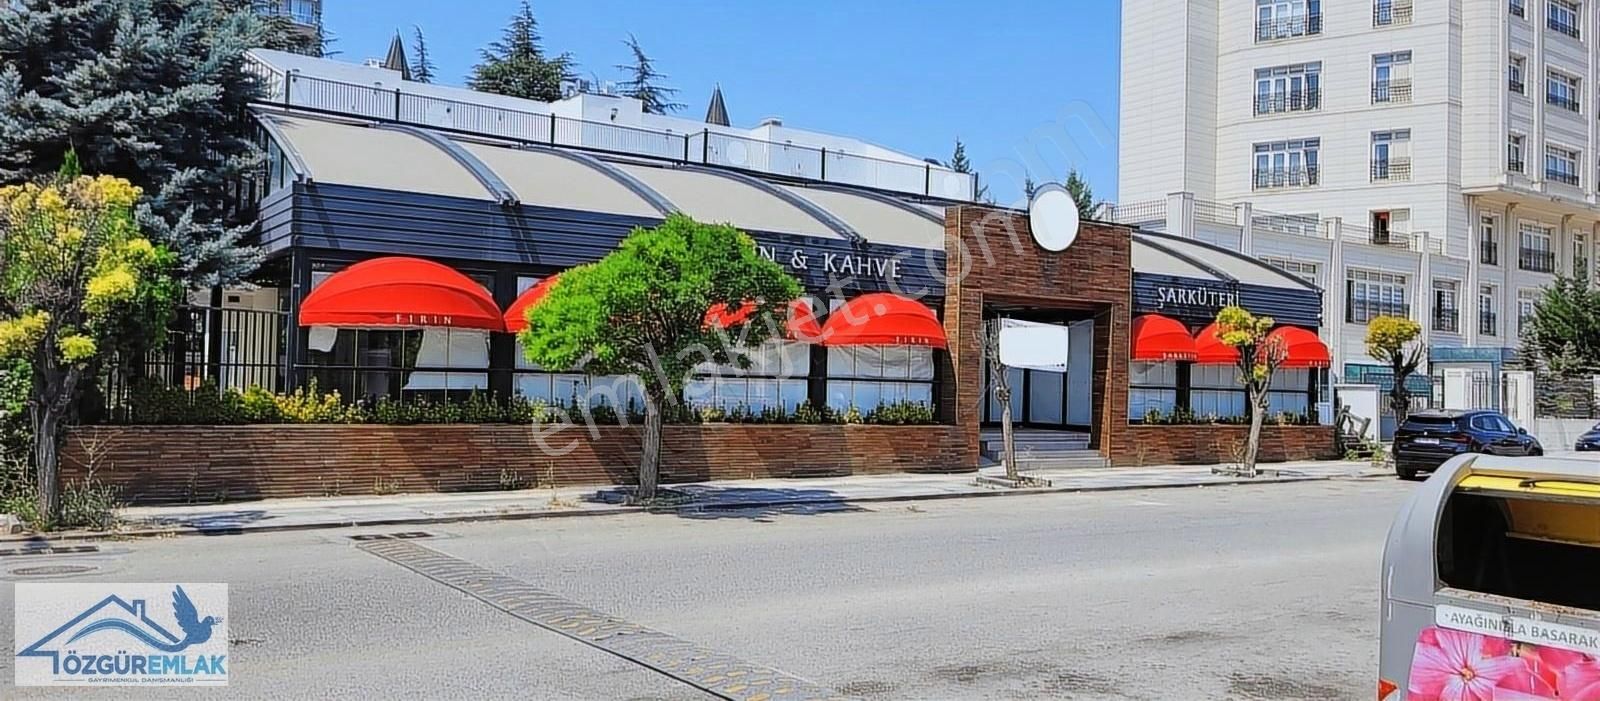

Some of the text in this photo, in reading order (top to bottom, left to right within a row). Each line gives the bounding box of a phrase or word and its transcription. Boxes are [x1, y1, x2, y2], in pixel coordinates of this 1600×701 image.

[791, 249, 808, 270] &
[824, 252, 902, 278] KAHVE
[1157, 287, 1240, 309] ŞARKÜTERİ
[396, 313, 452, 324] FIRIN
[1531, 625, 1598, 648] BASARAK
